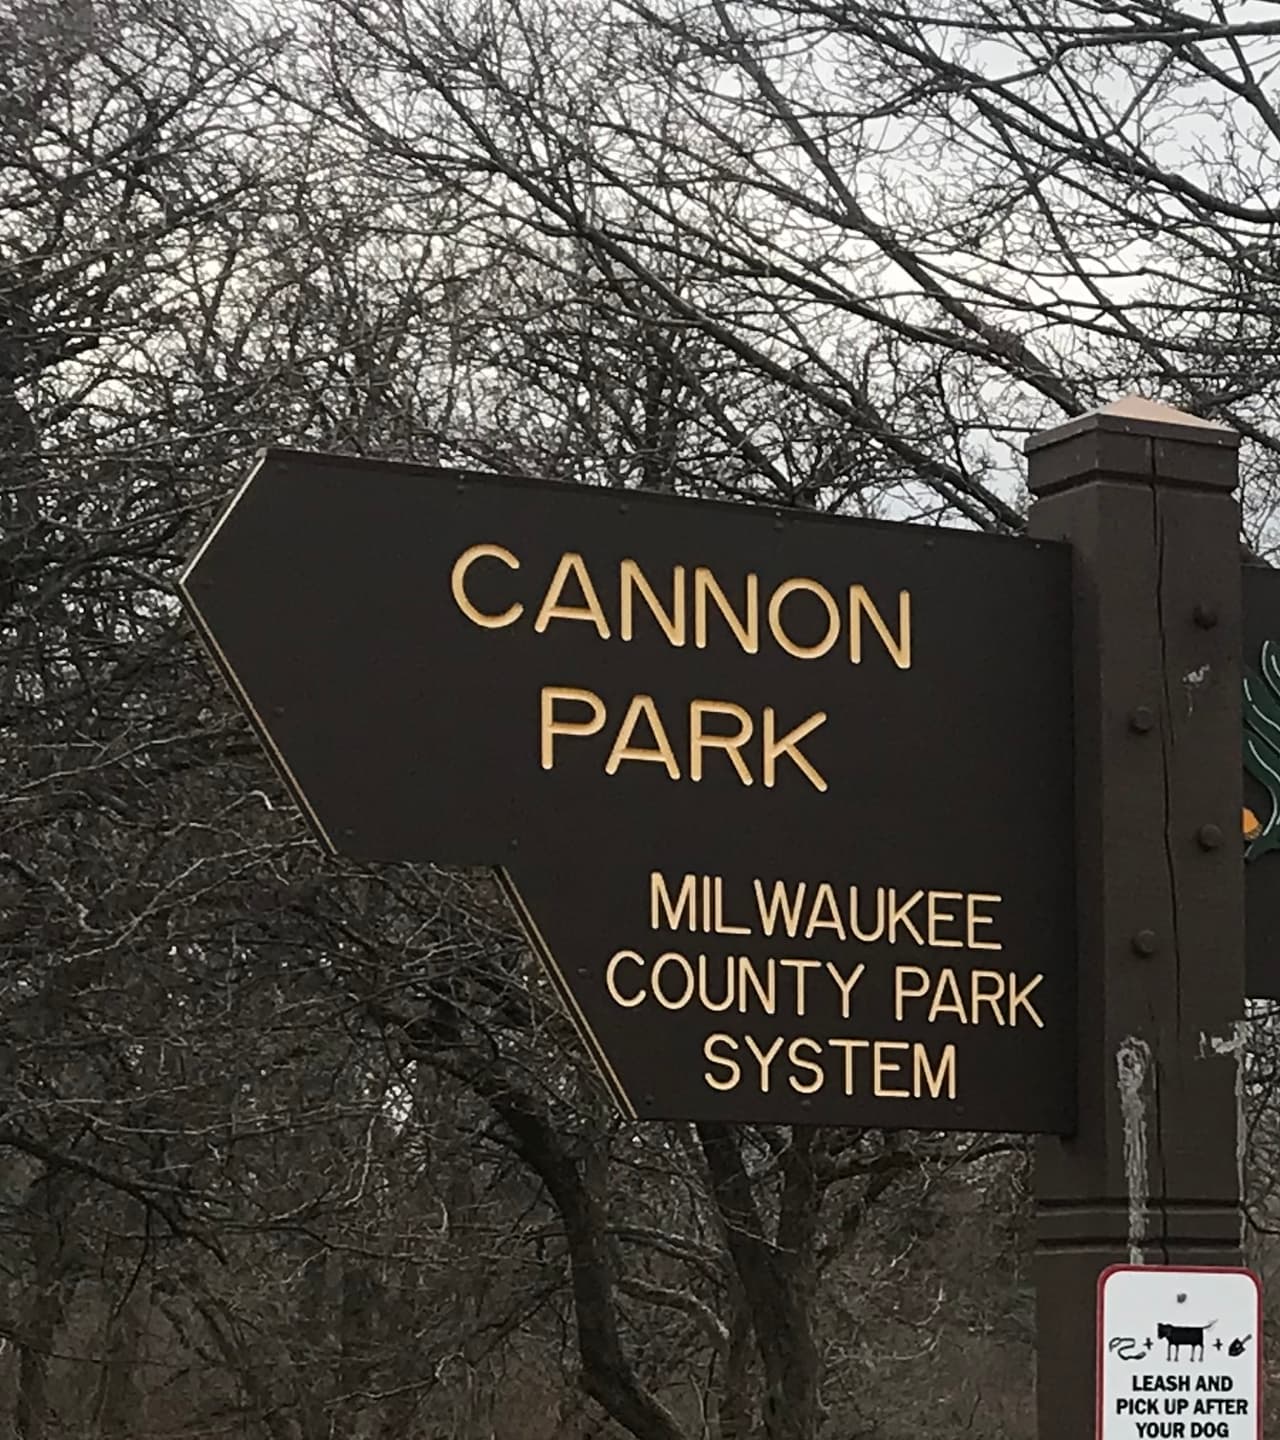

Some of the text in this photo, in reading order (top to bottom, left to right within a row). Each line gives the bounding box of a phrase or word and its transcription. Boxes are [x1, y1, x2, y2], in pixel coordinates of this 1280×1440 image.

[450, 542, 912, 670] CANNON
[539, 684, 829, 793] PARK
[649, 869, 1003, 952] MILWAUKEE
[604, 948, 1045, 1029] COUNTY PARK
[701, 1033, 958, 1101] SYSTEM
[1115, 1398, 1249, 1415] PICK UP AFTER
[1131, 1375, 1234, 1392] LEASH AND
[1135, 1422, 1230, 1439] YOUR DOG
